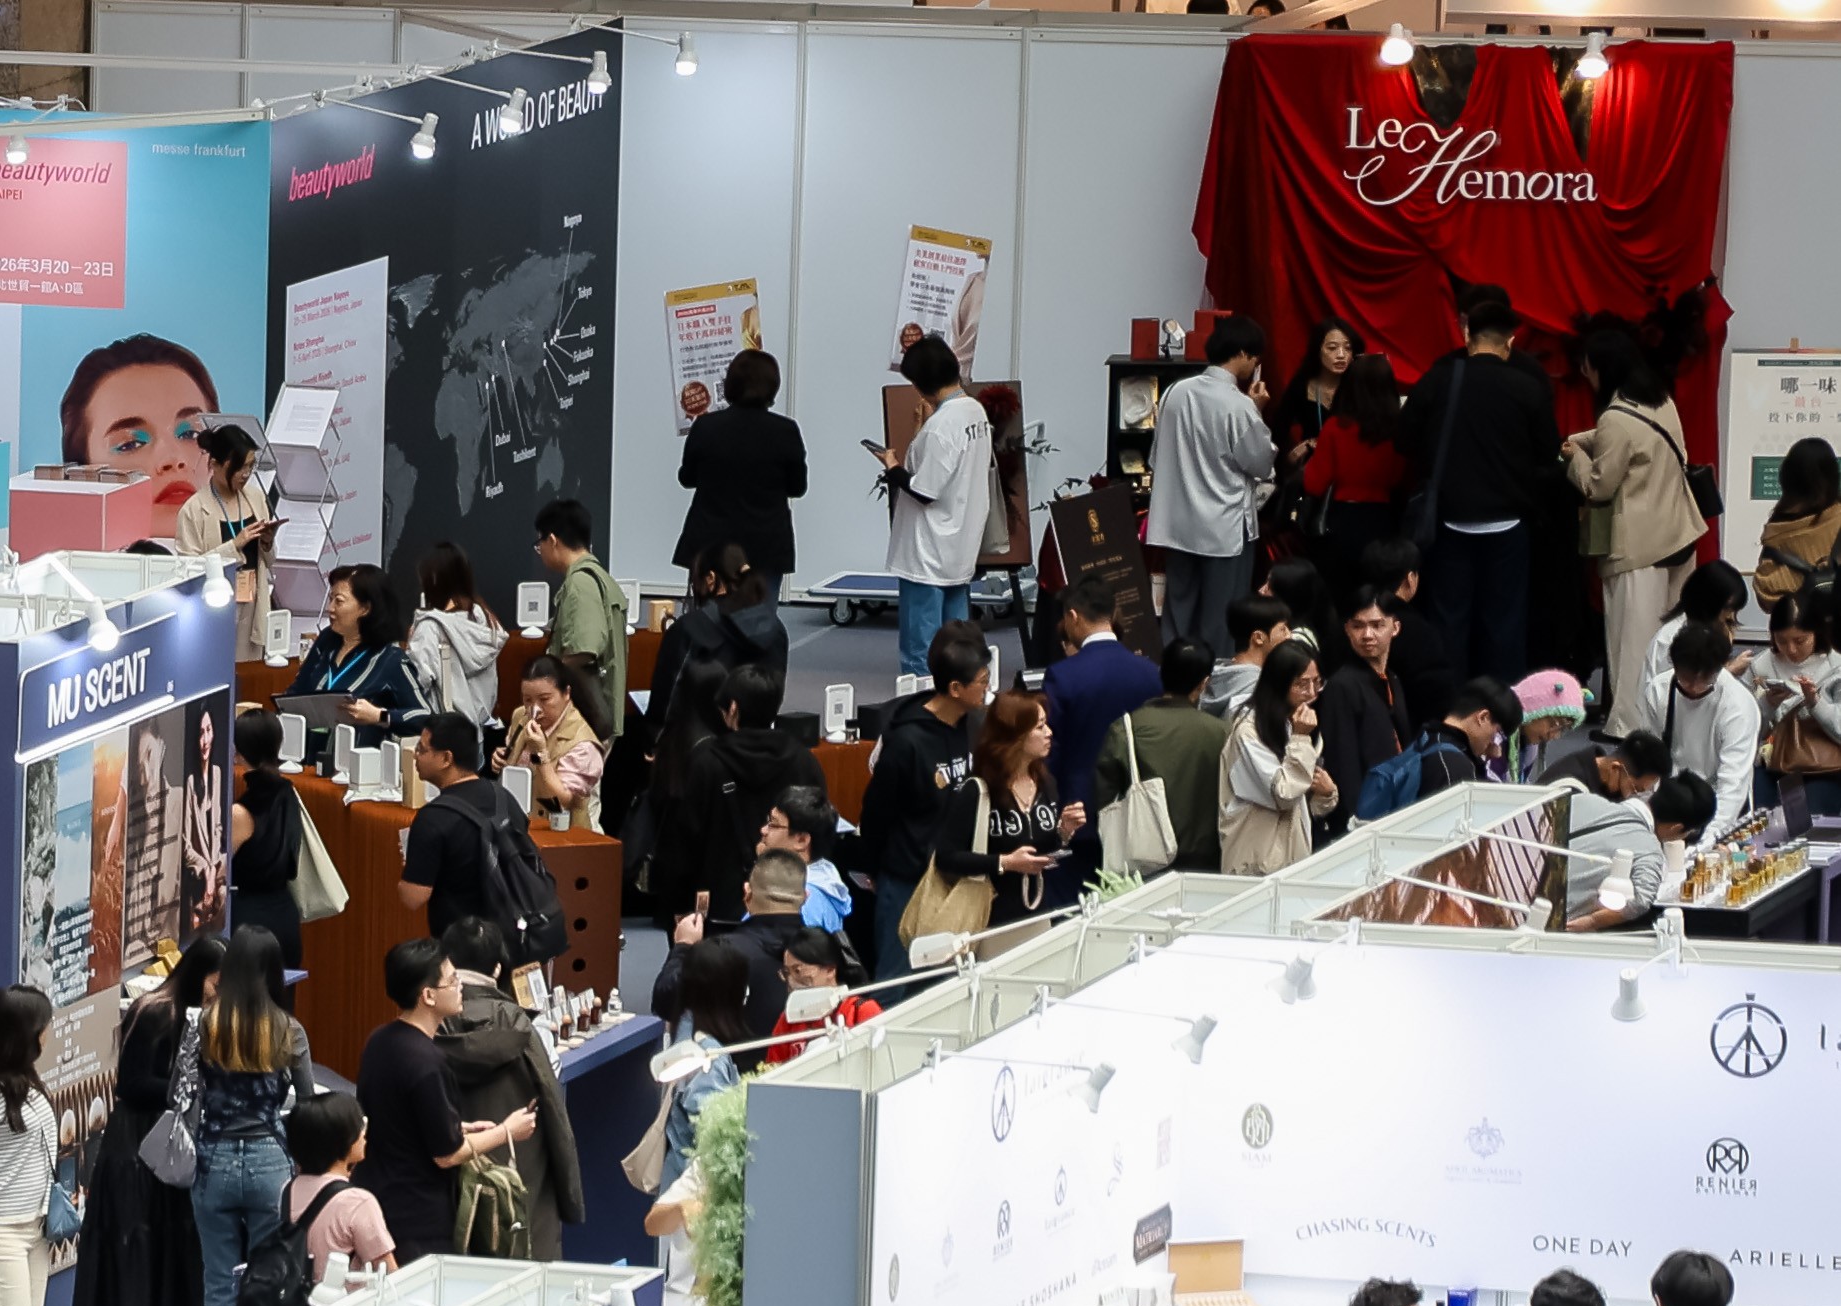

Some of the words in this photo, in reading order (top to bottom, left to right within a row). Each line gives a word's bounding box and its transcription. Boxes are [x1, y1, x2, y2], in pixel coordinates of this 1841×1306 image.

[470, 111, 482, 151] A
[537, 90, 556, 131] OF
[1344, 106, 1402, 150] Le
[151, 143, 190, 156] messe
[194, 143, 246, 158] frankfurt
[288, 142, 377, 203] beautyworld
[1343, 122, 1598, 206] Hemora
[47, 673, 82, 729] MU
[84, 646, 151, 713] SCENT
[1295, 1216, 1370, 1242] CHASING
[1373, 1218, 1438, 1248] SCENTS
[1532, 1235, 1581, 1254] ONE
[1589, 1238, 1633, 1258] DAY
[1729, 1249, 1841, 1271] ARIELLE
